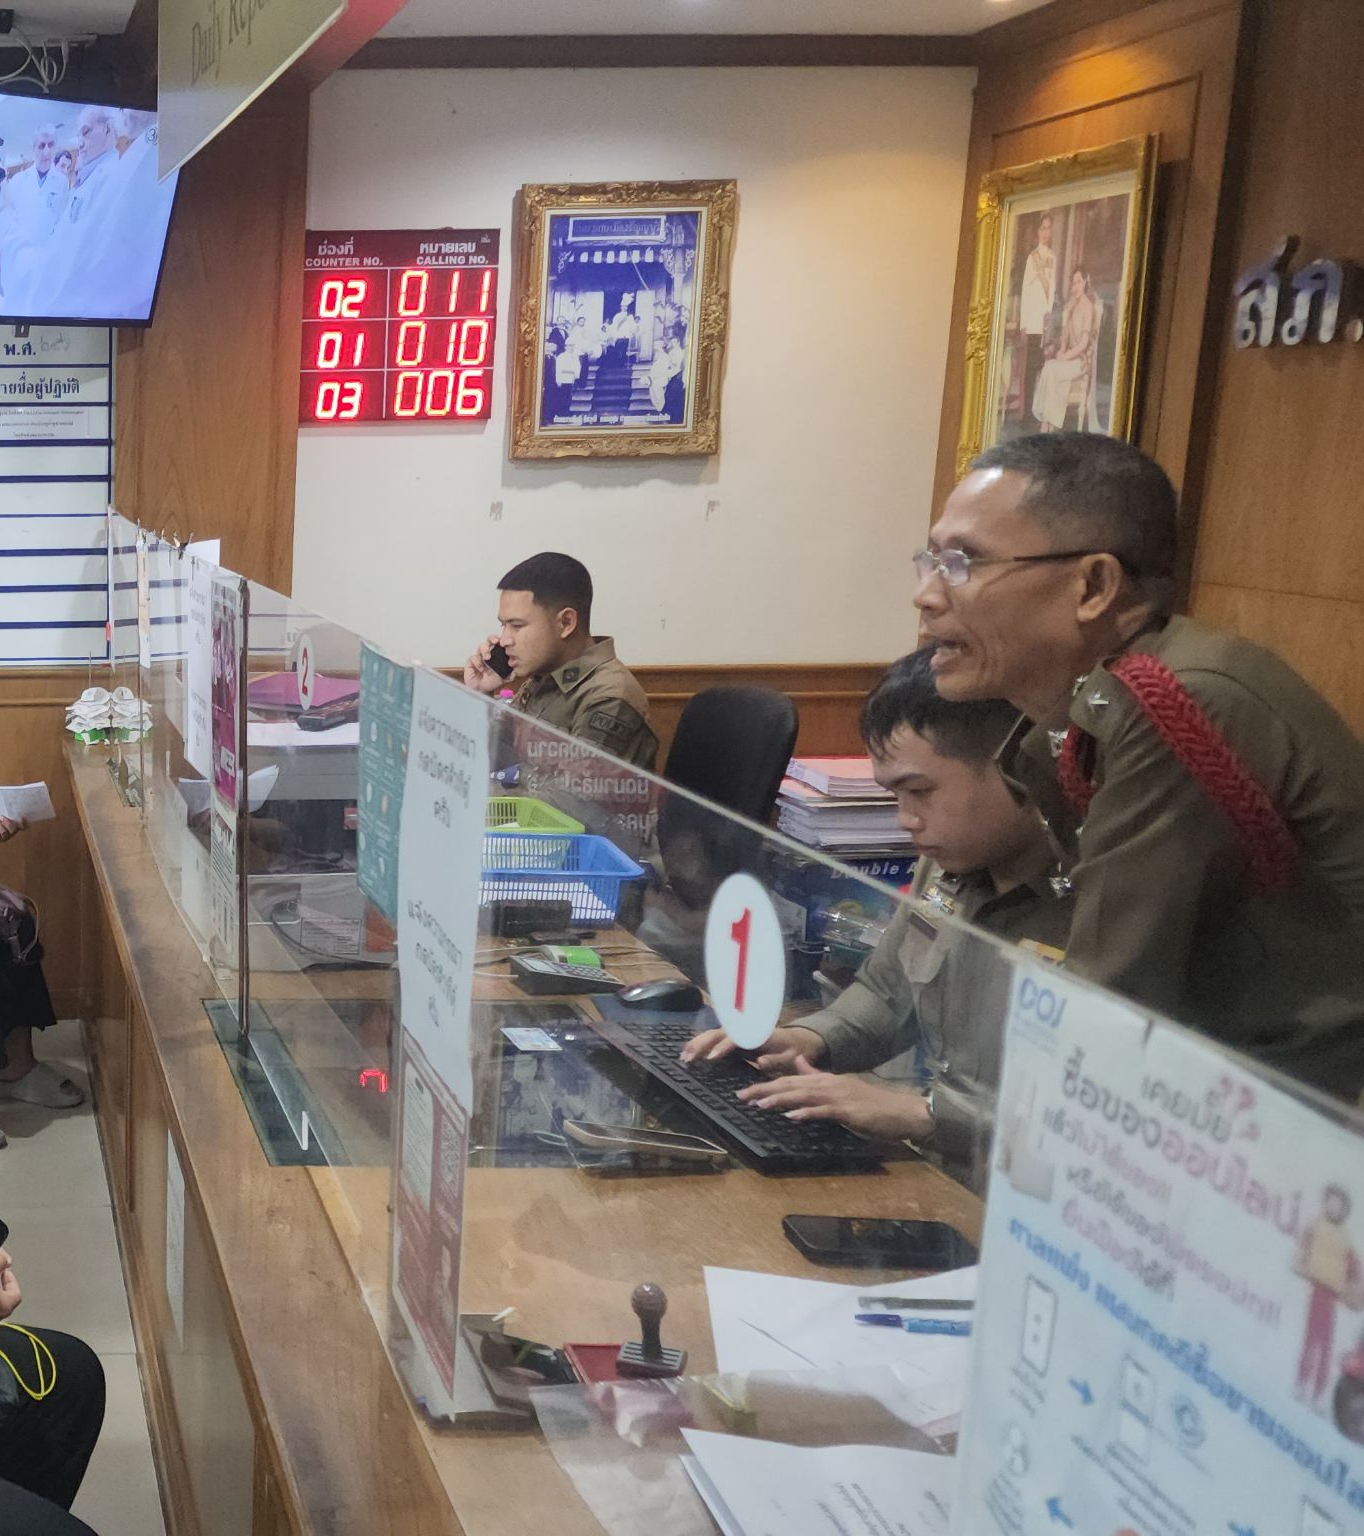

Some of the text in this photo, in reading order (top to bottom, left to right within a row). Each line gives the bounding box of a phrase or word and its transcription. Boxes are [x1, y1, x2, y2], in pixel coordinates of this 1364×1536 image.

[305, 256, 384, 267] COUNTER NO.
[317, 236, 355, 256] ช่องที่
[416, 255, 489, 266] CALLING NO.
[419, 241, 477, 255] หมายเลข
[318, 279, 367, 318] 02
[397, 270, 492, 316] 011
[3, 340, 37, 356] พ.ศ.
[316, 330, 365, 369] 01
[396, 319, 489, 366] 010
[315, 381, 363, 419] 03
[393, 369, 484, 417] 006
[730, 906, 752, 1014] 1
